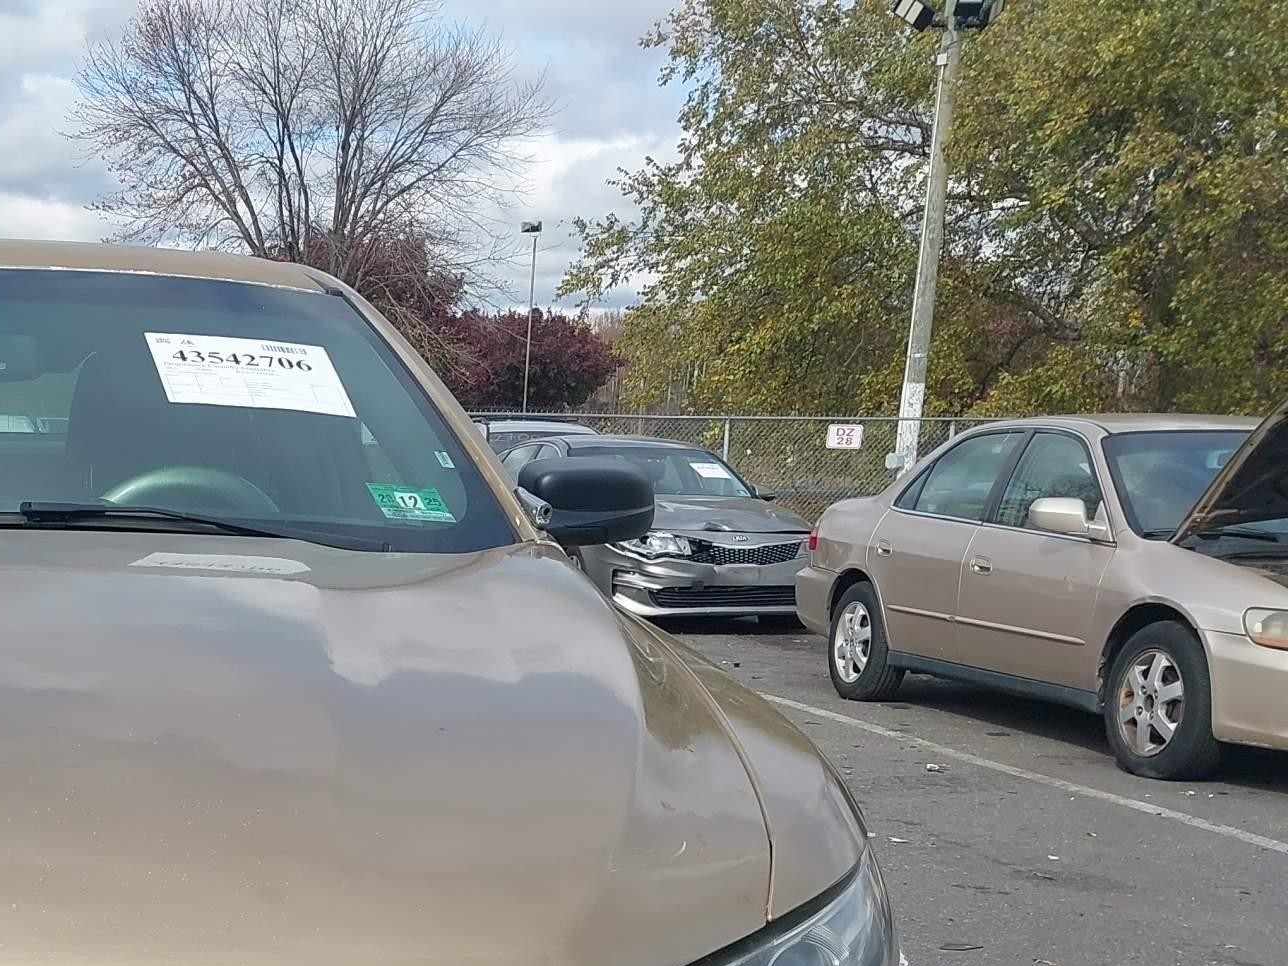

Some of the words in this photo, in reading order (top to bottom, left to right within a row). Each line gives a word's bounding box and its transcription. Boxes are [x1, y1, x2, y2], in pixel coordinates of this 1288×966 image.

[172, 349, 313, 373] 43542706
[835, 427, 856, 437] DZ
[836, 436, 853, 446] 28
